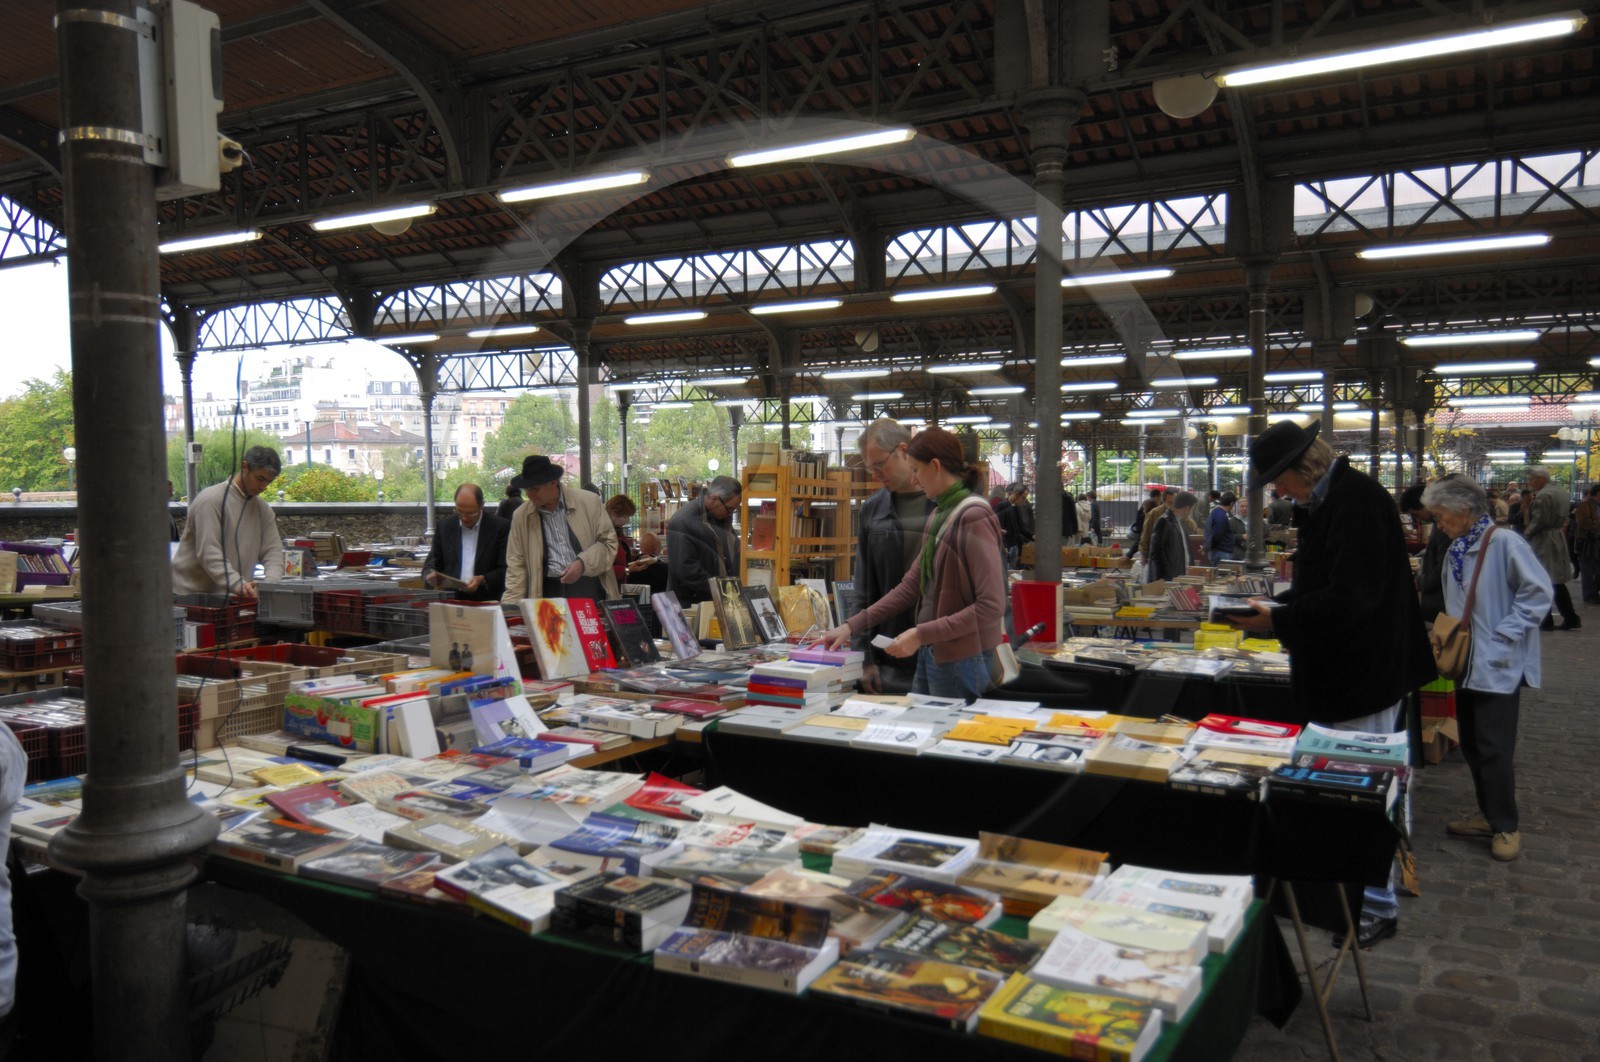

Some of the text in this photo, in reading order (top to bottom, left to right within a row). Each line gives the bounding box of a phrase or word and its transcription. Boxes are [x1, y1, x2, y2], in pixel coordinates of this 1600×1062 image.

[575, 610, 586, 618] LES
[578, 618, 599, 626] ROLLING
[581, 626, 599, 635] STONES
